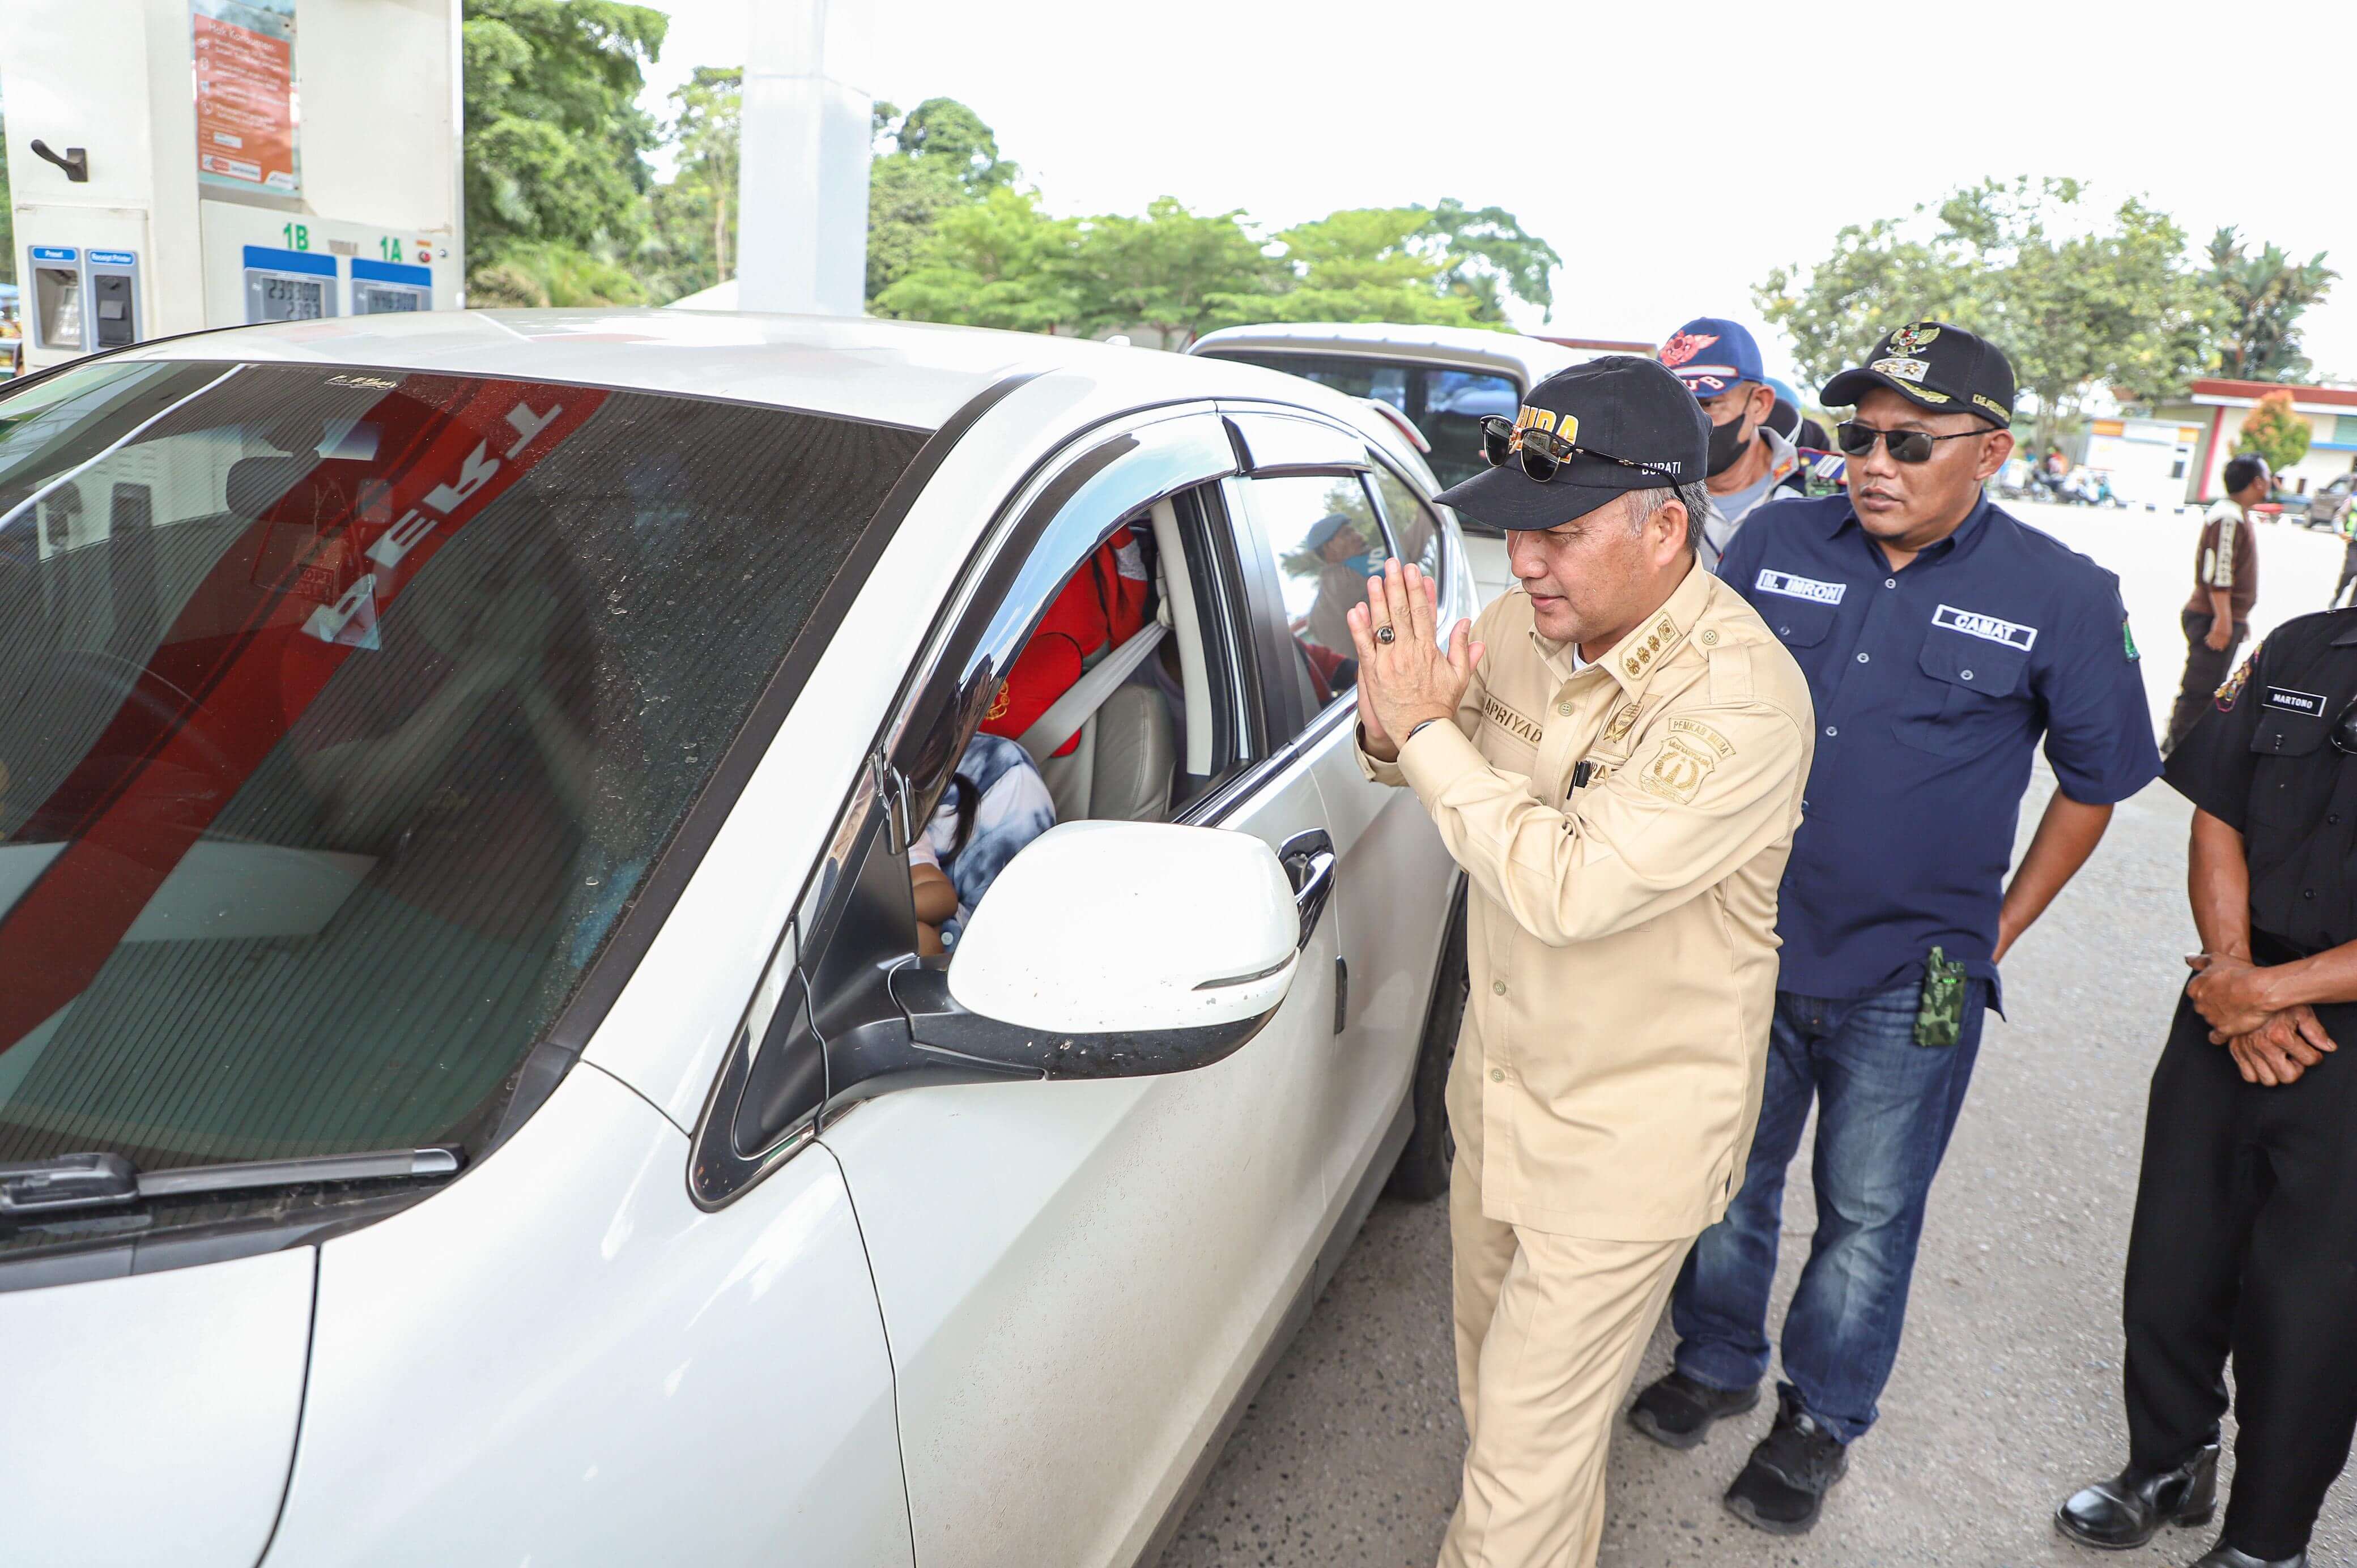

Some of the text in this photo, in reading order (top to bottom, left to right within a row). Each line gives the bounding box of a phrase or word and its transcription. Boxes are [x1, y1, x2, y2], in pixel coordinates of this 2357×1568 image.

[284, 221, 309, 251] 1B
[380, 235, 403, 263] 1A
[1641, 461, 1682, 475] BUPATI
[1762, 573, 1840, 600] M. IMRON
[1954, 615, 2017, 641] CAMAT
[2272, 693, 2313, 709] MARTONO
[1673, 720, 1707, 736] PEMKAB
